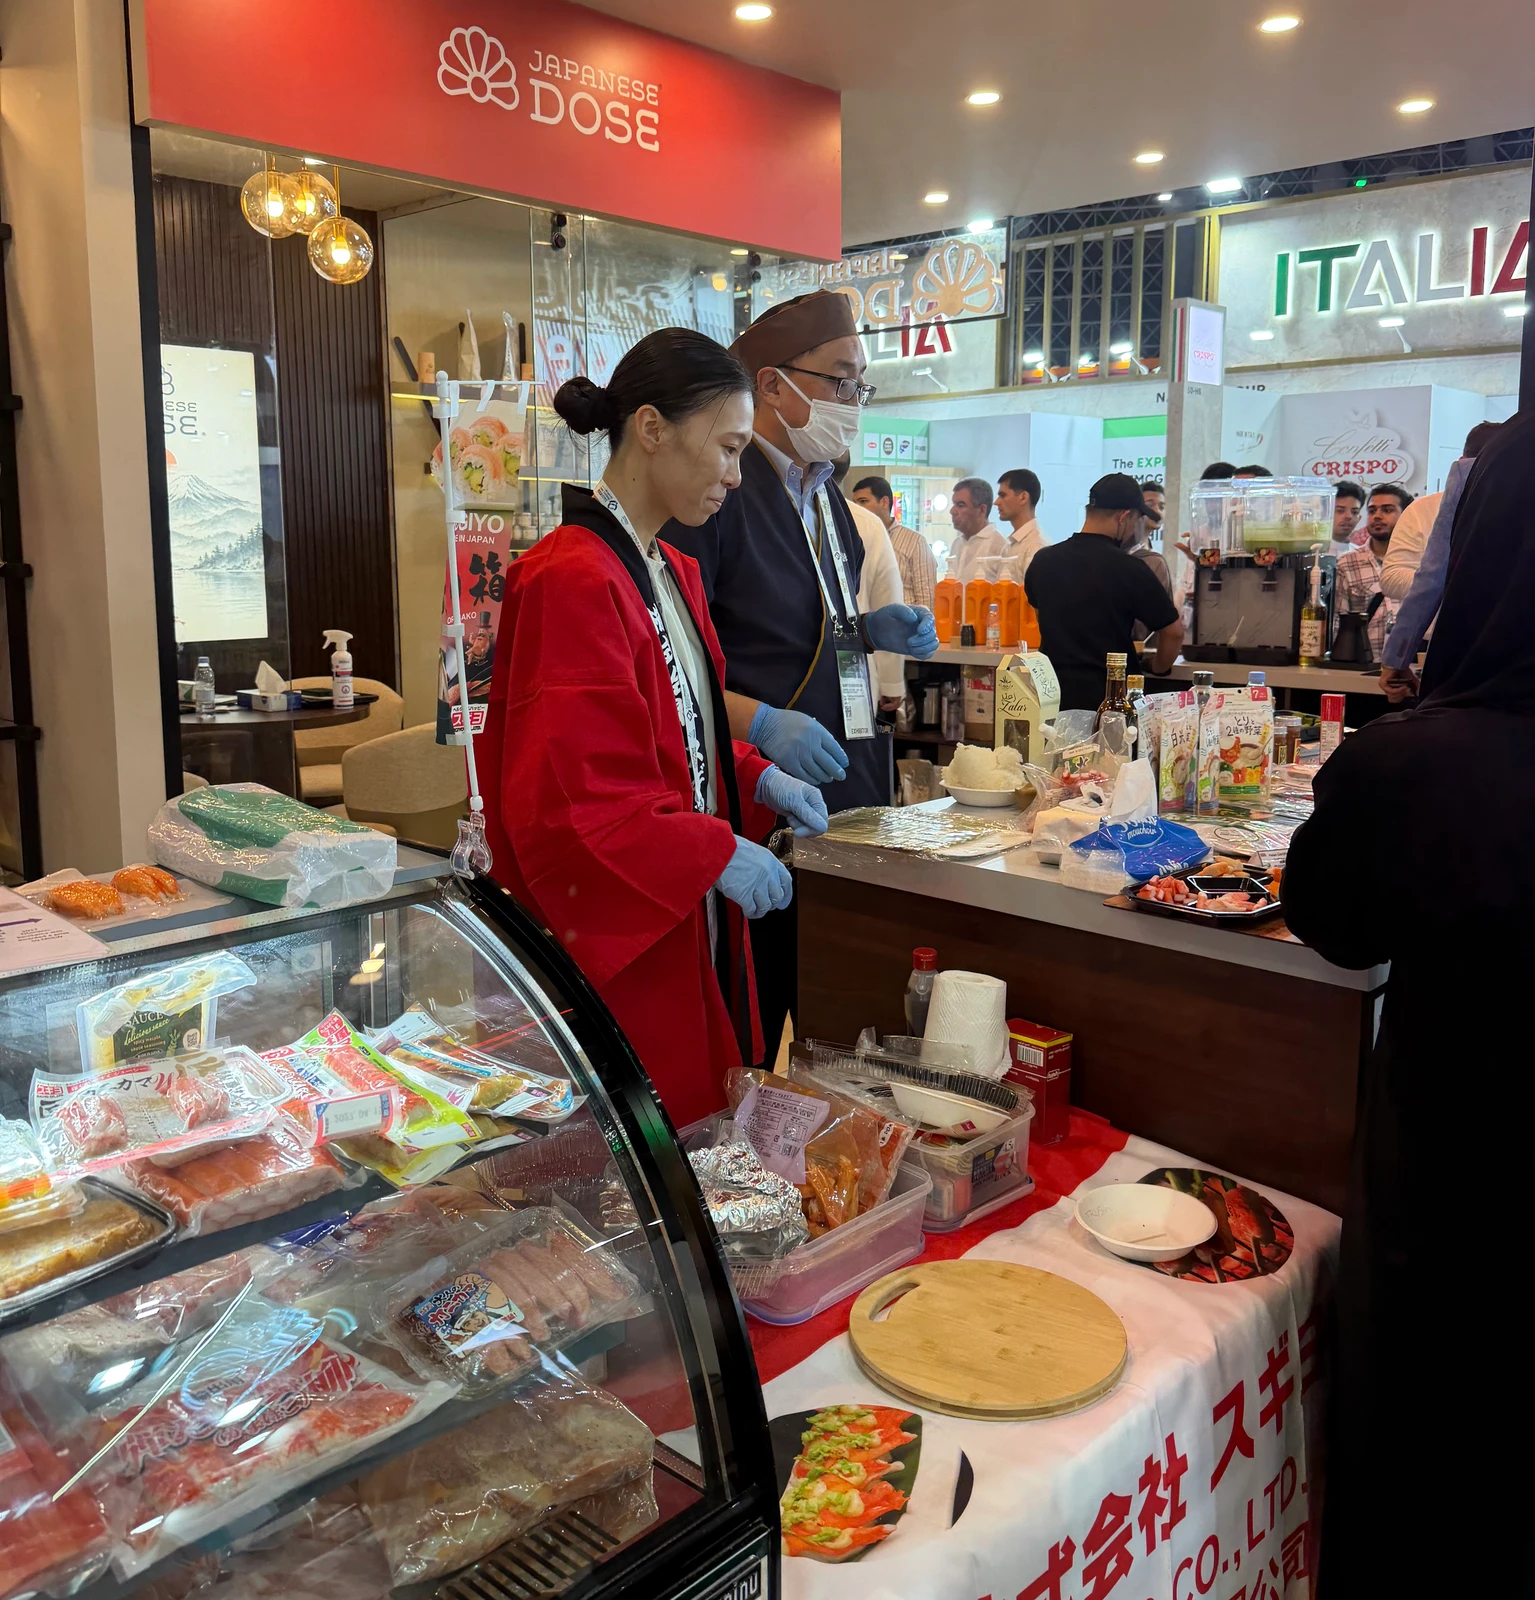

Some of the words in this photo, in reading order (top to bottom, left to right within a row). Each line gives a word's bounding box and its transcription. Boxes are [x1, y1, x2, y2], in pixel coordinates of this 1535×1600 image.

[529, 50, 660, 106] JAPANESE
[529, 78, 660, 152] DOSE
[1112, 459, 1133, 469] The
[1311, 459, 1398, 478] CRISPO
[467, 535, 496, 544] JAPAN
[452, 712, 483, 726] スヨ
[125, 1011, 164, 1027] SAUCE
[428, 1283, 476, 1326] カニカマ
